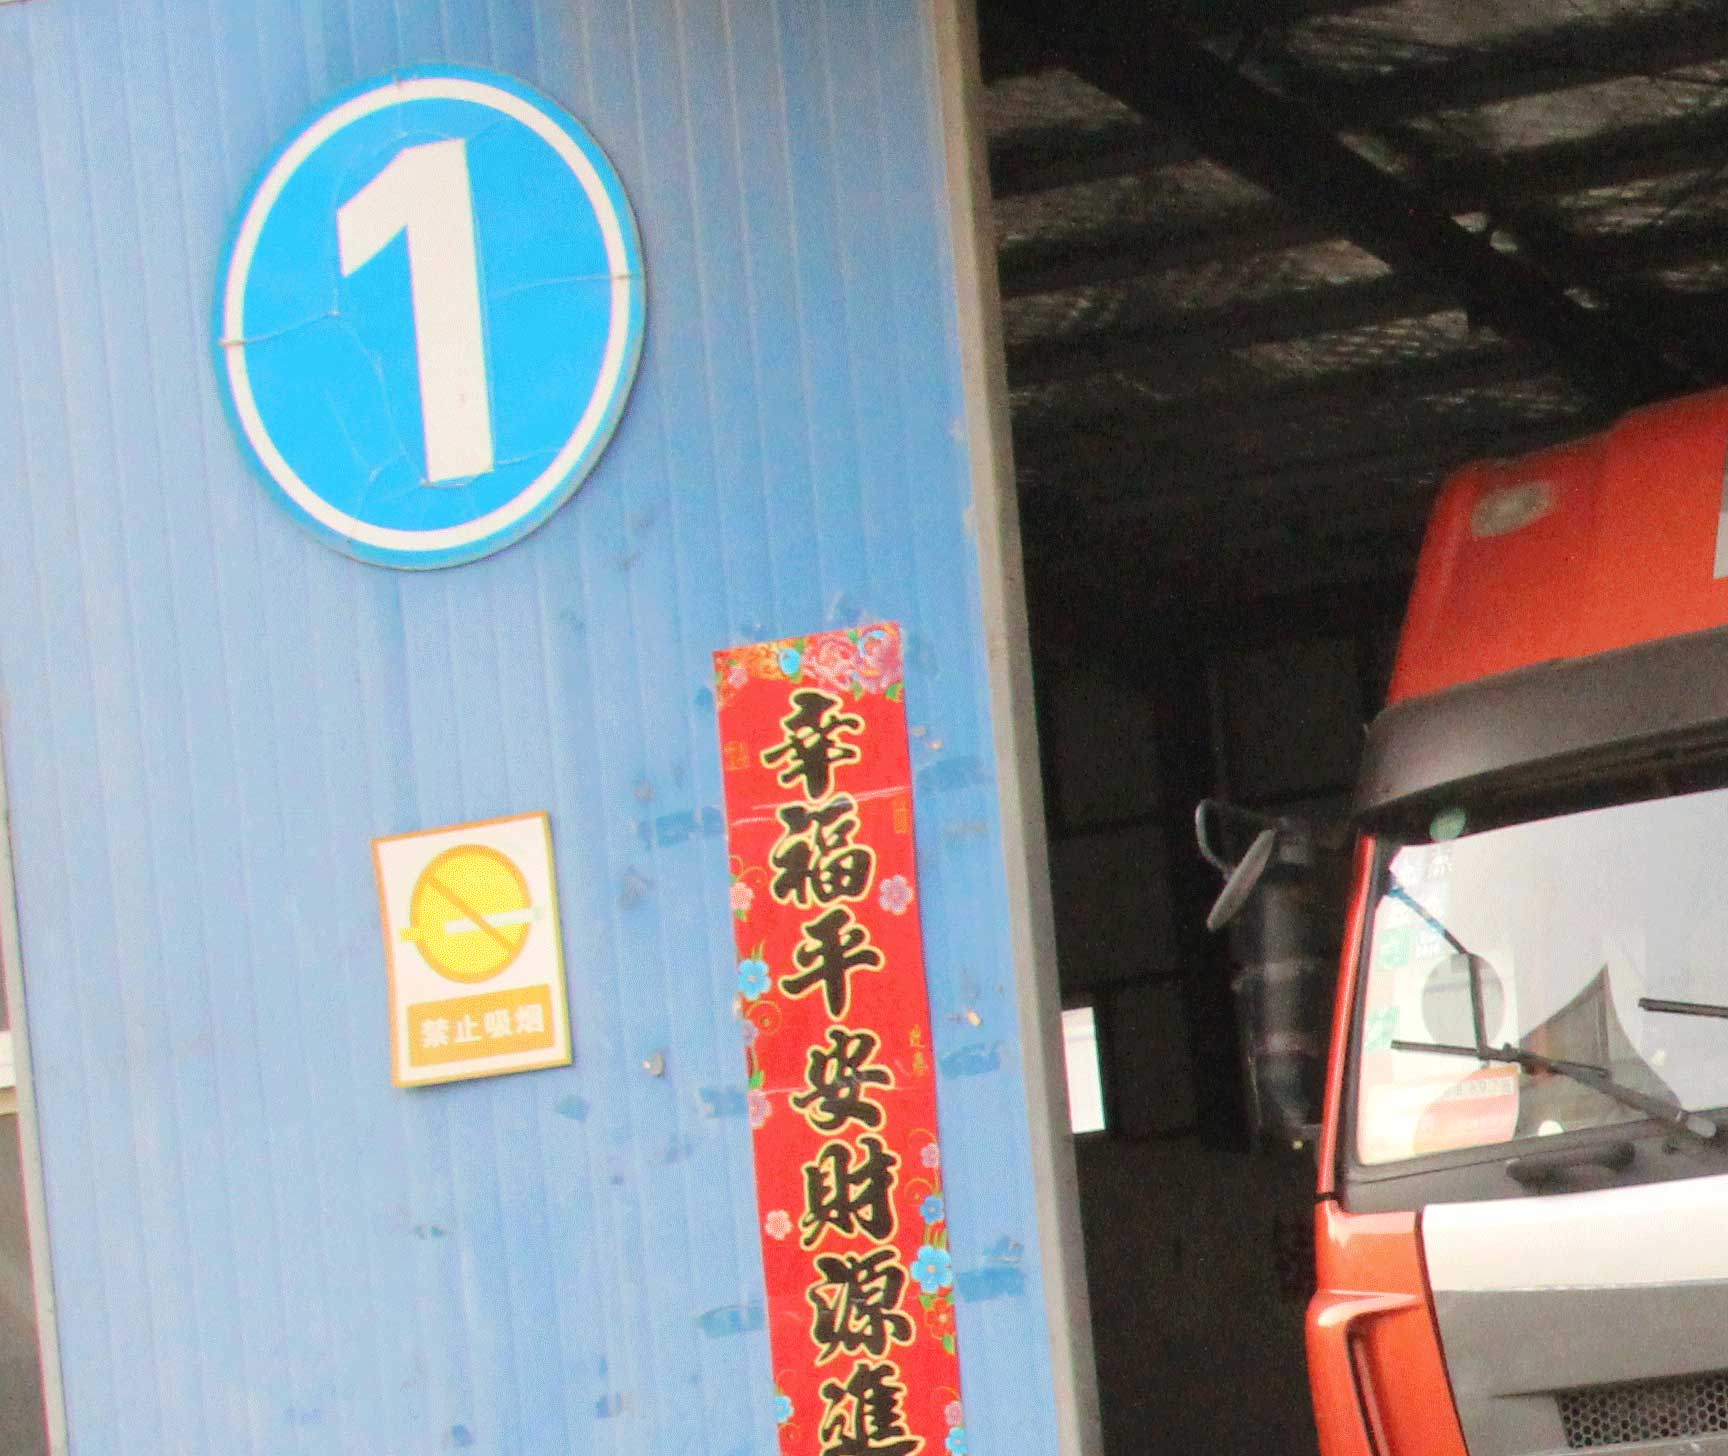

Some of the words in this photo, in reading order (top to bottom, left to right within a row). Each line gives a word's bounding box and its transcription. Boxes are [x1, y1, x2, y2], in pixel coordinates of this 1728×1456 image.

[335, 136, 495, 485] 1
[420, 1003, 545, 1049] 禁止吸烟
